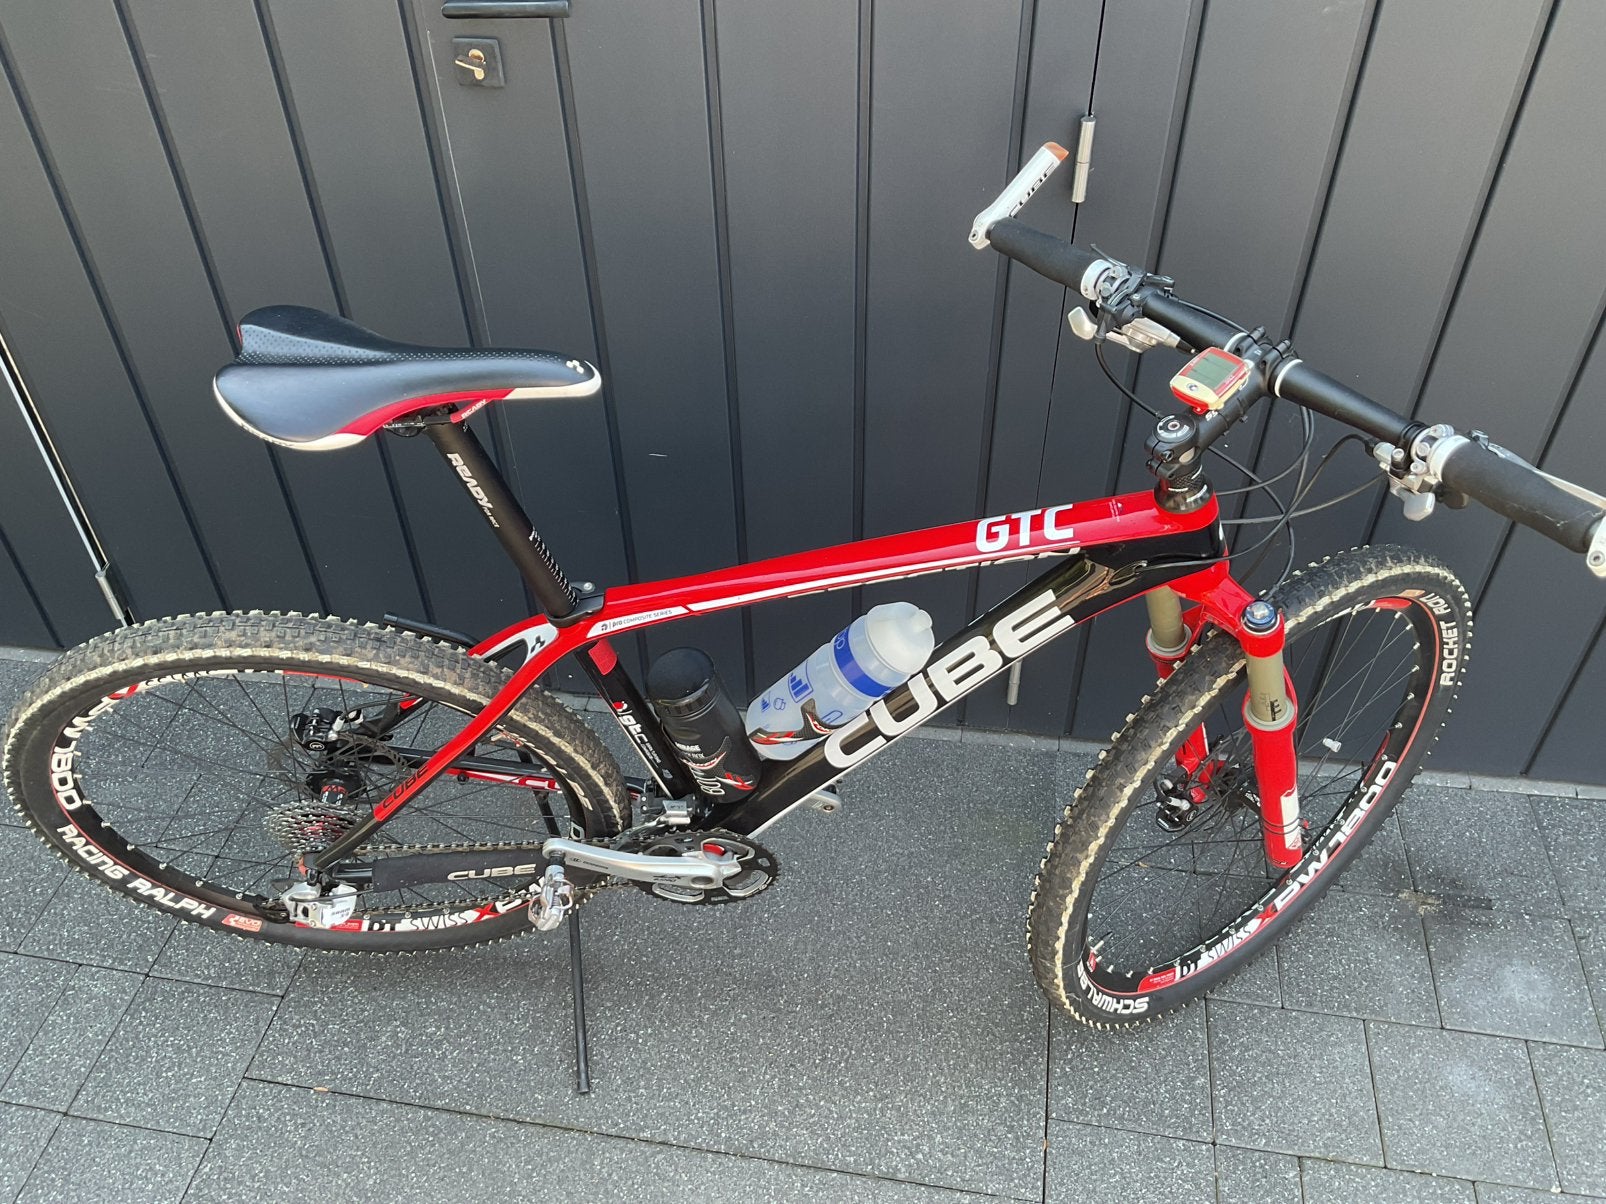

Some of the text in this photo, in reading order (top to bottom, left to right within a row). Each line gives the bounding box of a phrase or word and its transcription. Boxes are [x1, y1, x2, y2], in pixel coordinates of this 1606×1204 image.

[446, 452, 494, 509] READY
[976, 504, 1074, 553] GTC
[623, 613, 651, 625] COMPOSITE
[652, 608, 673, 620] SERIES
[1419, 592, 1459, 686] ROCKET RON
[823, 588, 1075, 769] CUBE
[383, 764, 430, 809] CUBE
[57, 823, 217, 919] RACING RALPH
[447, 863, 537, 881] CUBE
